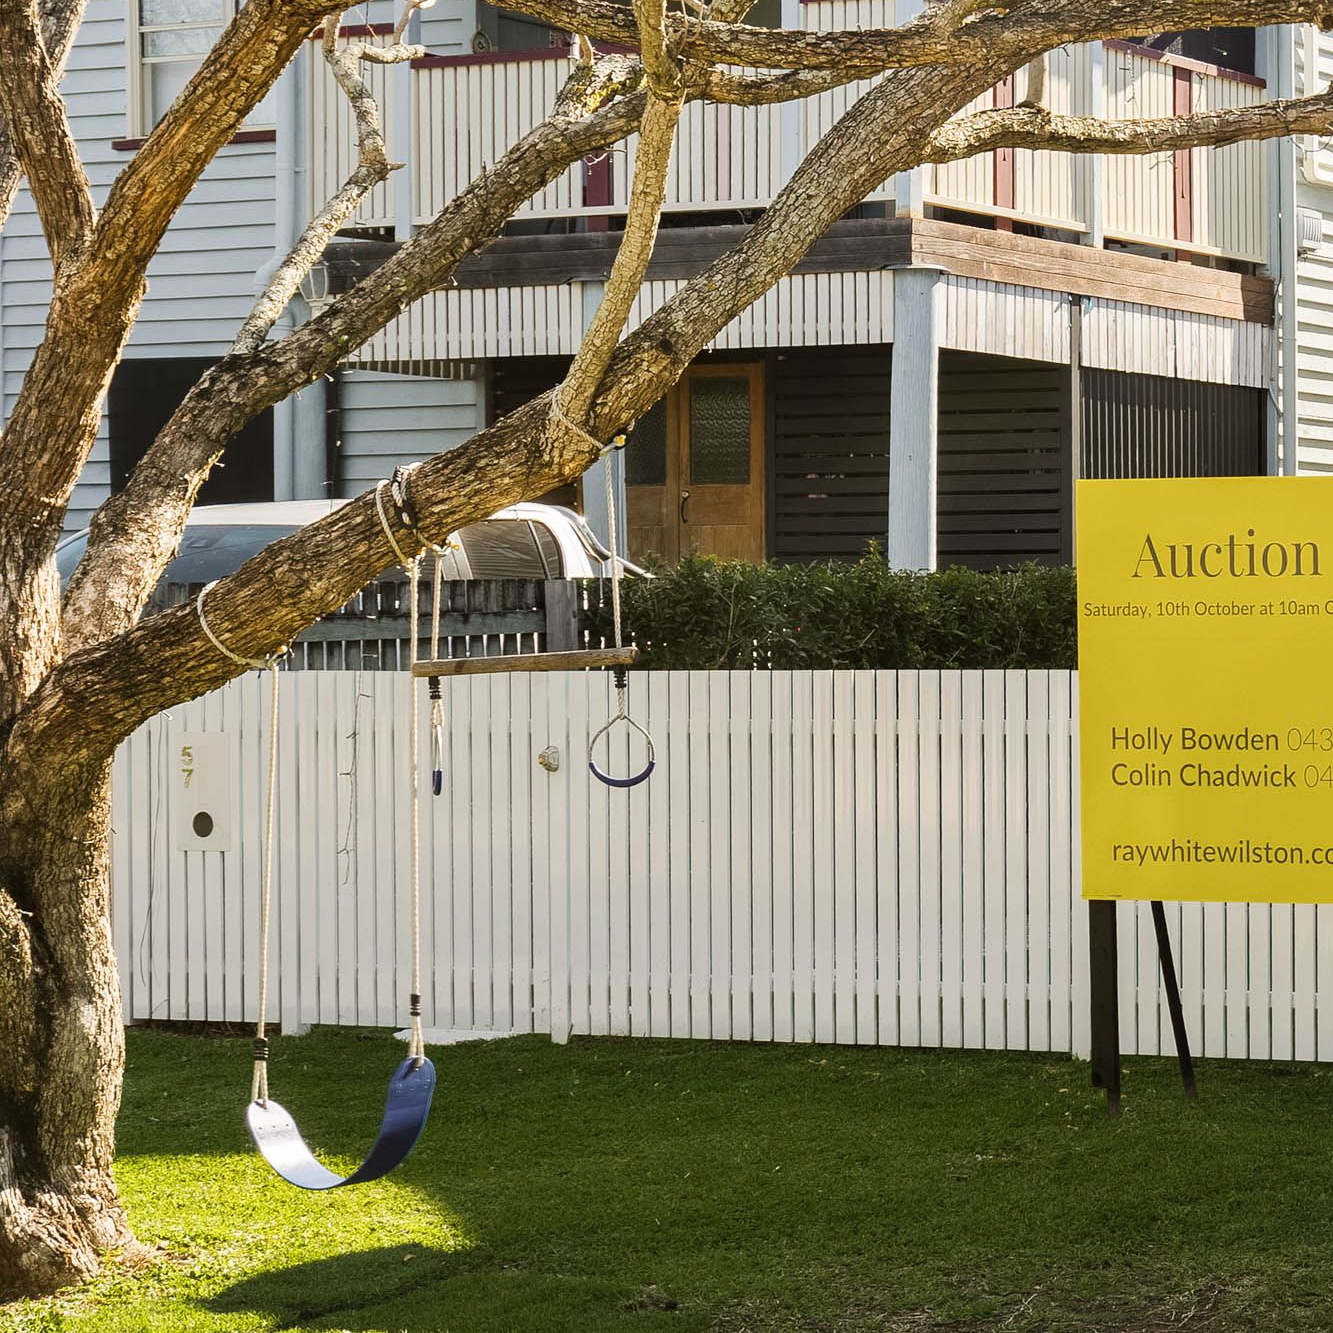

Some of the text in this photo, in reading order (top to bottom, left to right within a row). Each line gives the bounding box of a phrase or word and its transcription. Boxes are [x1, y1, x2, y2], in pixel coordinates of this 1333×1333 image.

[1131, 528, 1324, 579] Auction
[1083, 602, 1152, 619] Saturday,
[1156, 601, 1190, 617] 10th
[1194, 600, 1256, 616] October
[1259, 601, 1274, 615] at
[1279, 600, 1320, 615] 10am
[1110, 726, 1172, 754] Holly
[1180, 727, 1280, 752] Bowden
[1110, 763, 1172, 787] Colin
[1179, 763, 1297, 788] Chadwick
